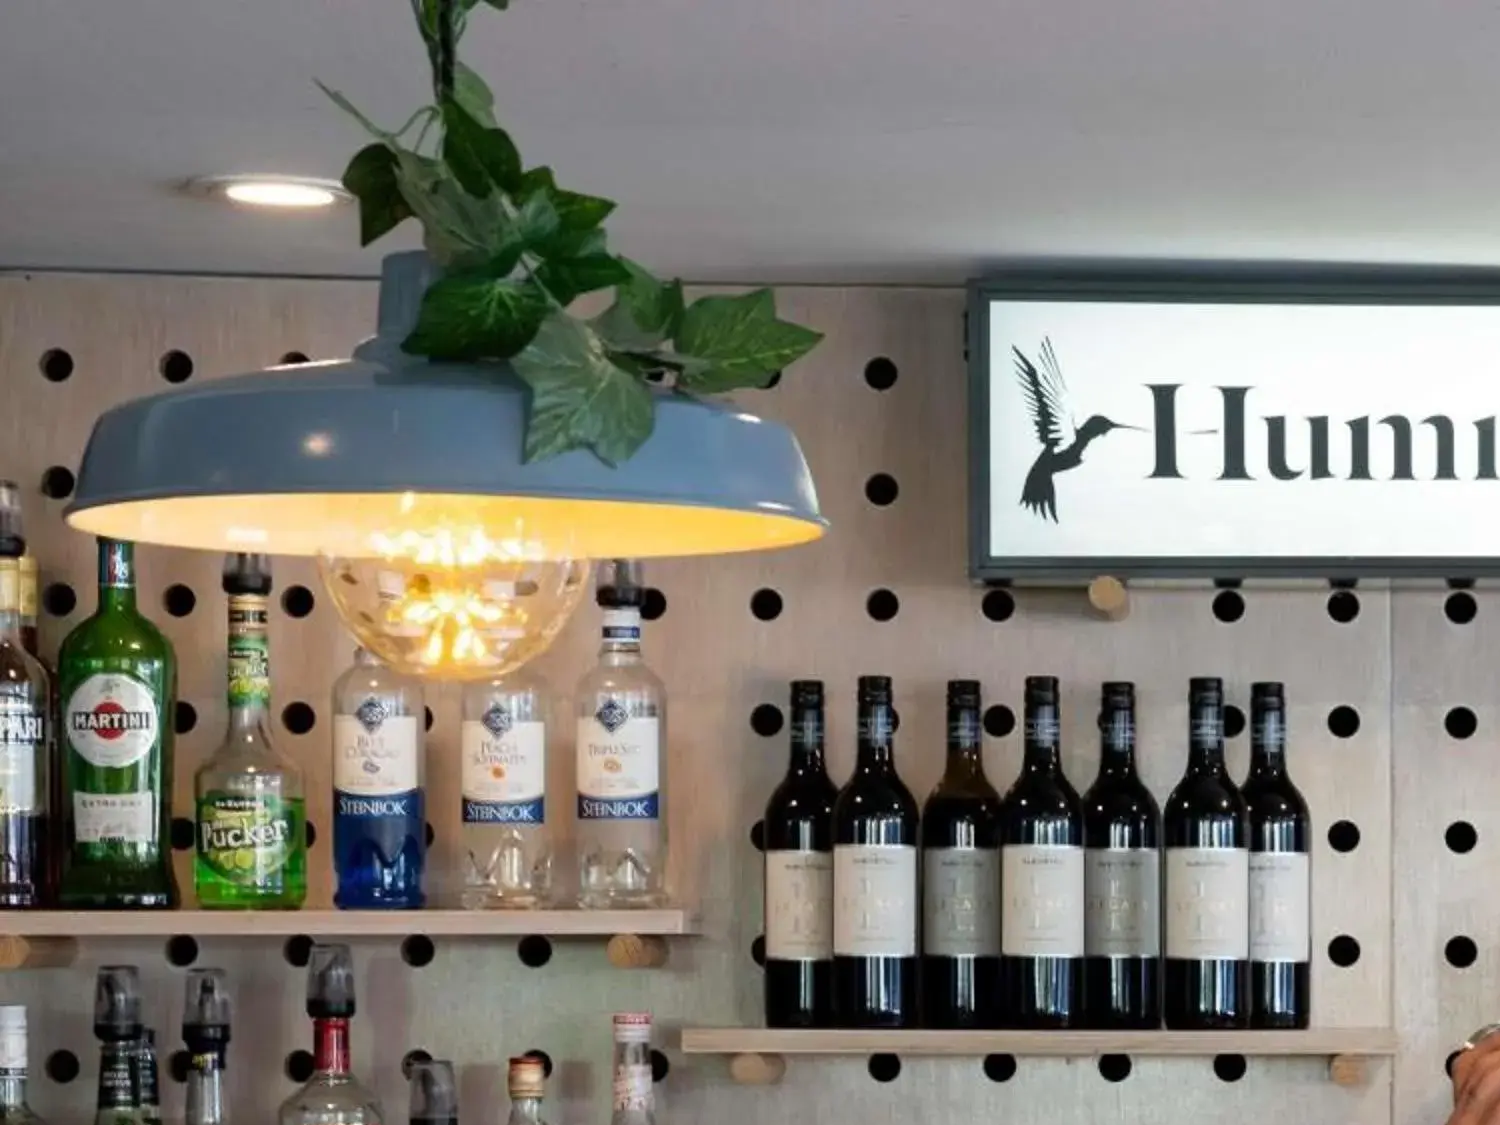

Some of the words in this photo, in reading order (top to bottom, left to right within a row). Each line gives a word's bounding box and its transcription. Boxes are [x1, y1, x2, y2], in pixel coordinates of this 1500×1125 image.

[0, 714, 44, 739] PARI
[73, 712, 151, 730] MARTINI
[339, 798, 408, 816] STEINBOK
[468, 803, 535, 821] STEINBOK
[582, 799, 649, 817] STEINBOK
[201, 817, 288, 854] Pucker
